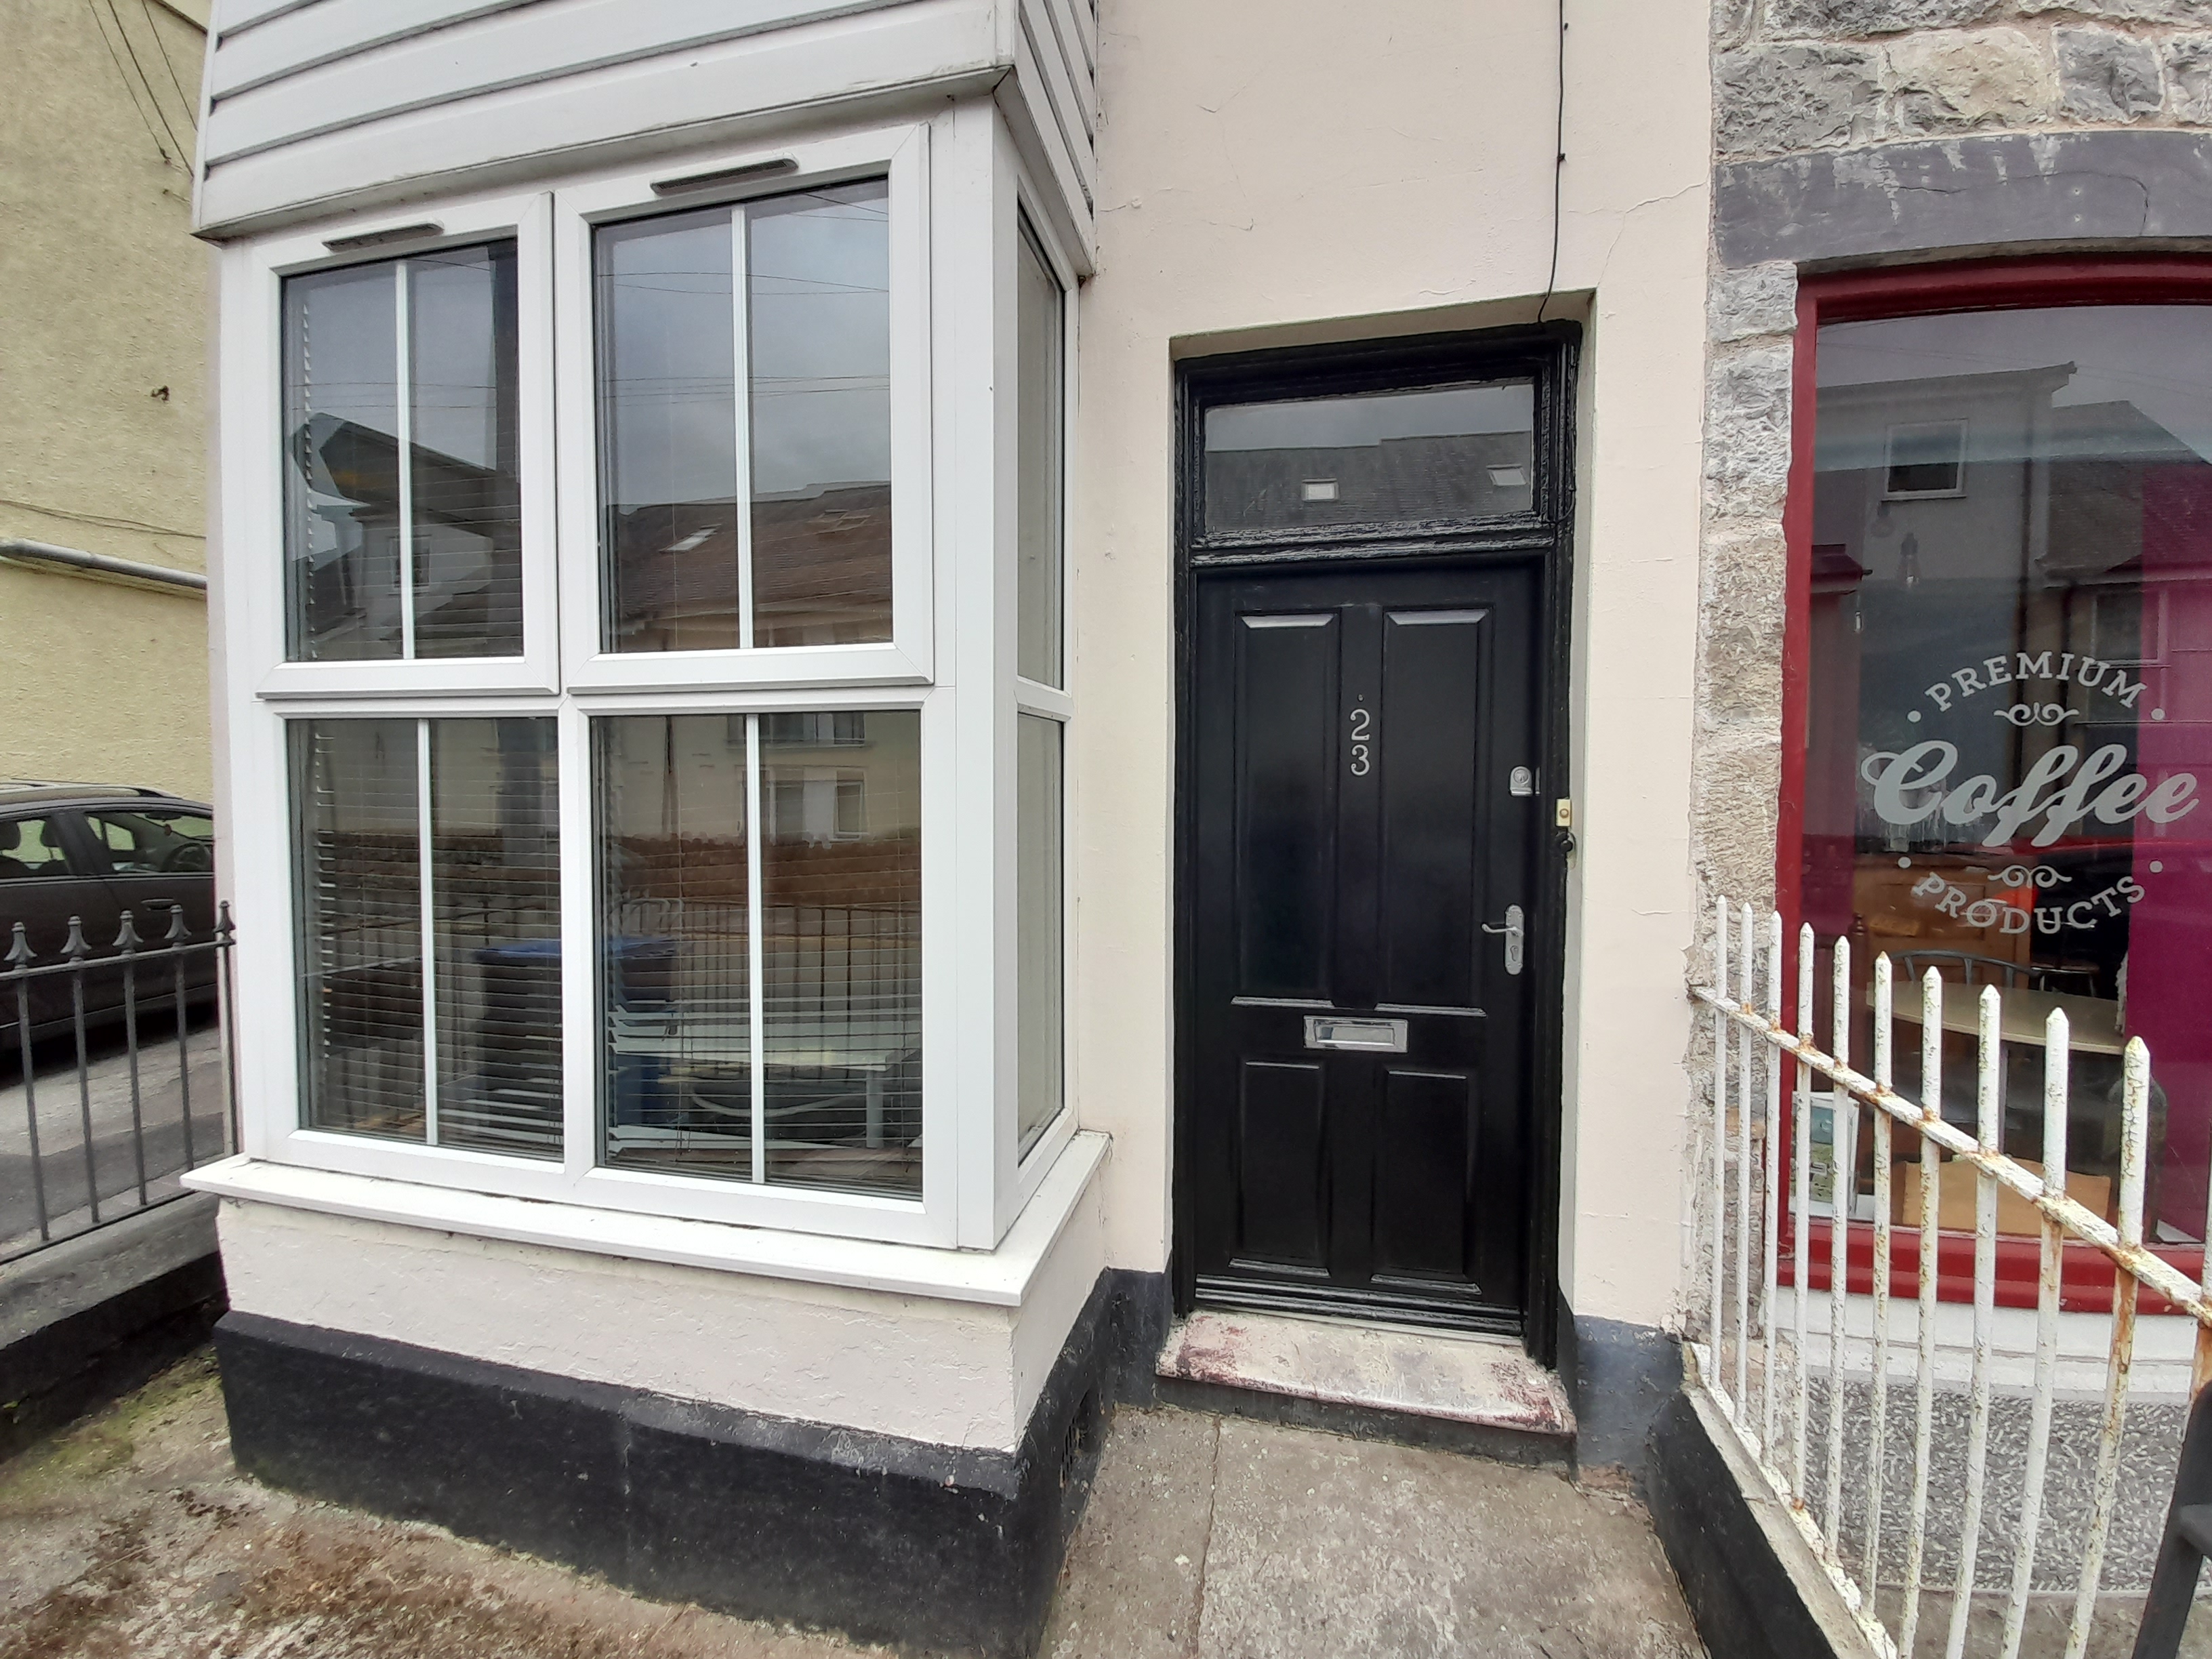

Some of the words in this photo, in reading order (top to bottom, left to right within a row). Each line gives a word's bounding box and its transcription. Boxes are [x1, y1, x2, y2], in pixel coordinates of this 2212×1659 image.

[1925, 651, 2147, 712] PREMIUM
[1350, 708, 1370, 776] 23
[1860, 740, 2200, 847] Coffee
[1911, 872, 2146, 934] PRODUCTS
